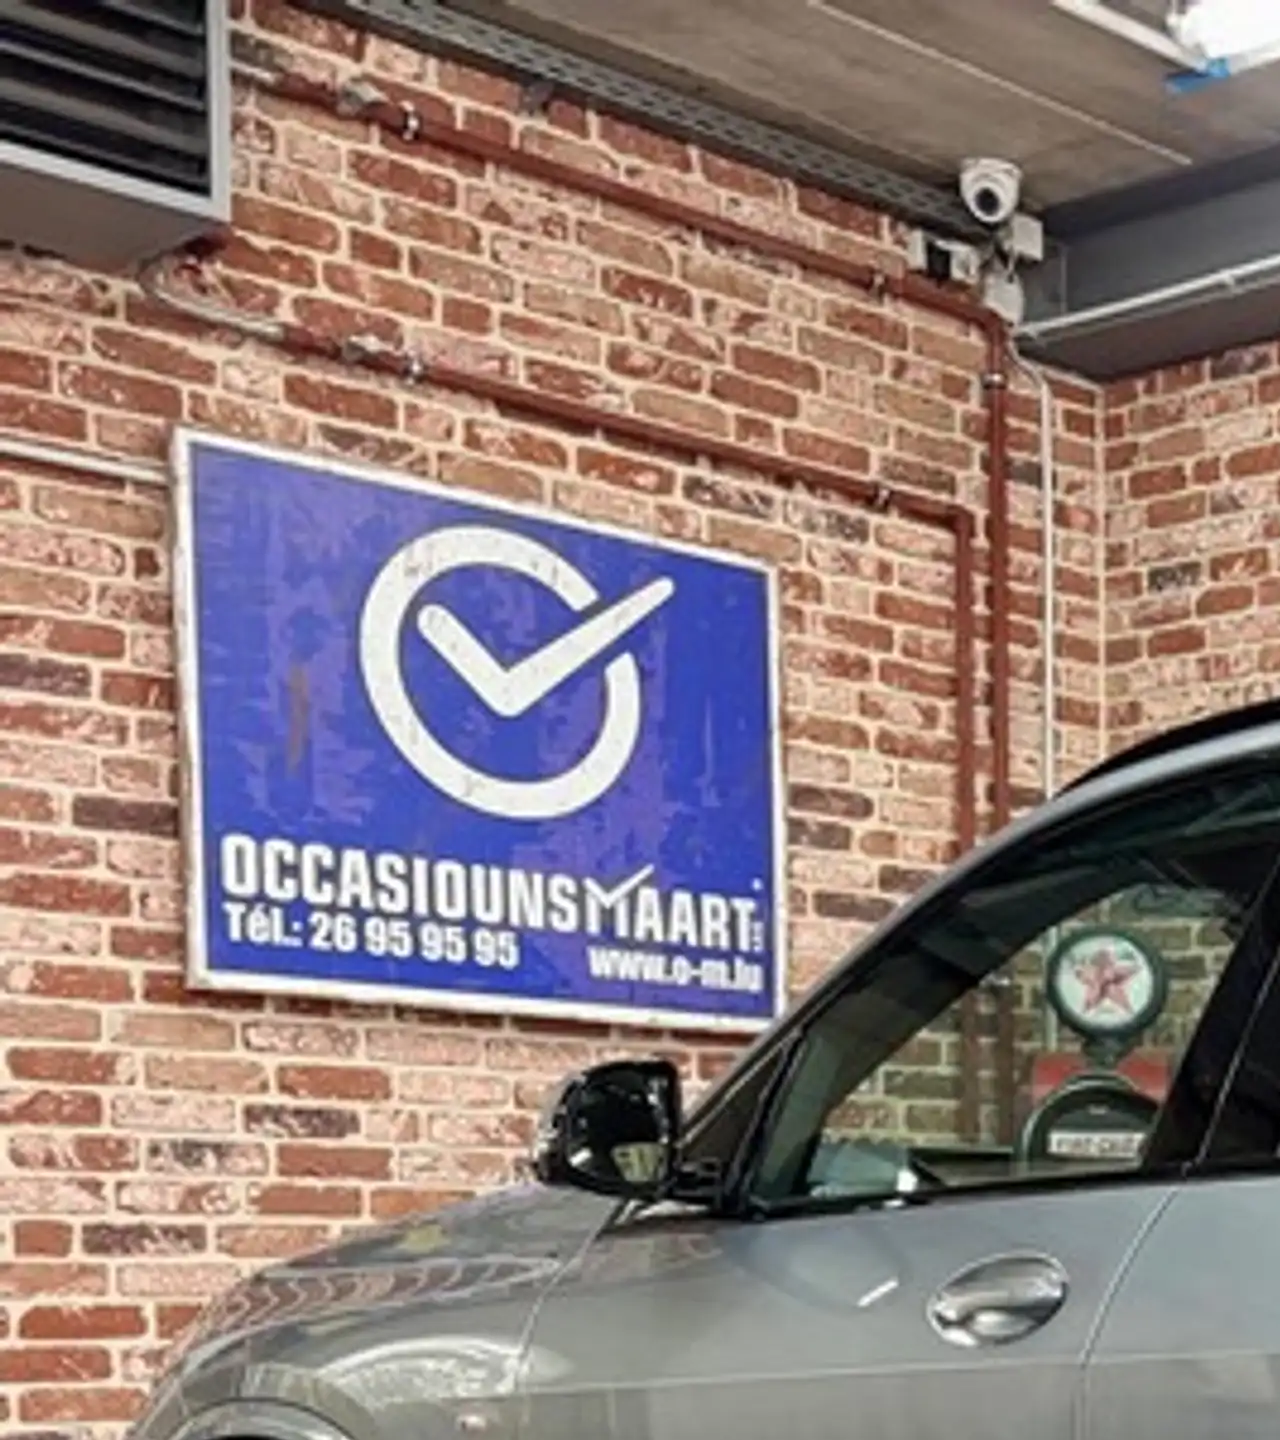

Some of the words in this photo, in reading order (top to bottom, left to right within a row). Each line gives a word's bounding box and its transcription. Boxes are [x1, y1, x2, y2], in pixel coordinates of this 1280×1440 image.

[223, 901, 302, 947] Tél.:
[308, 911, 357, 952] 26
[364, 916, 413, 958] 95
[420, 922, 467, 964] 95
[473, 928, 520, 970] 95
